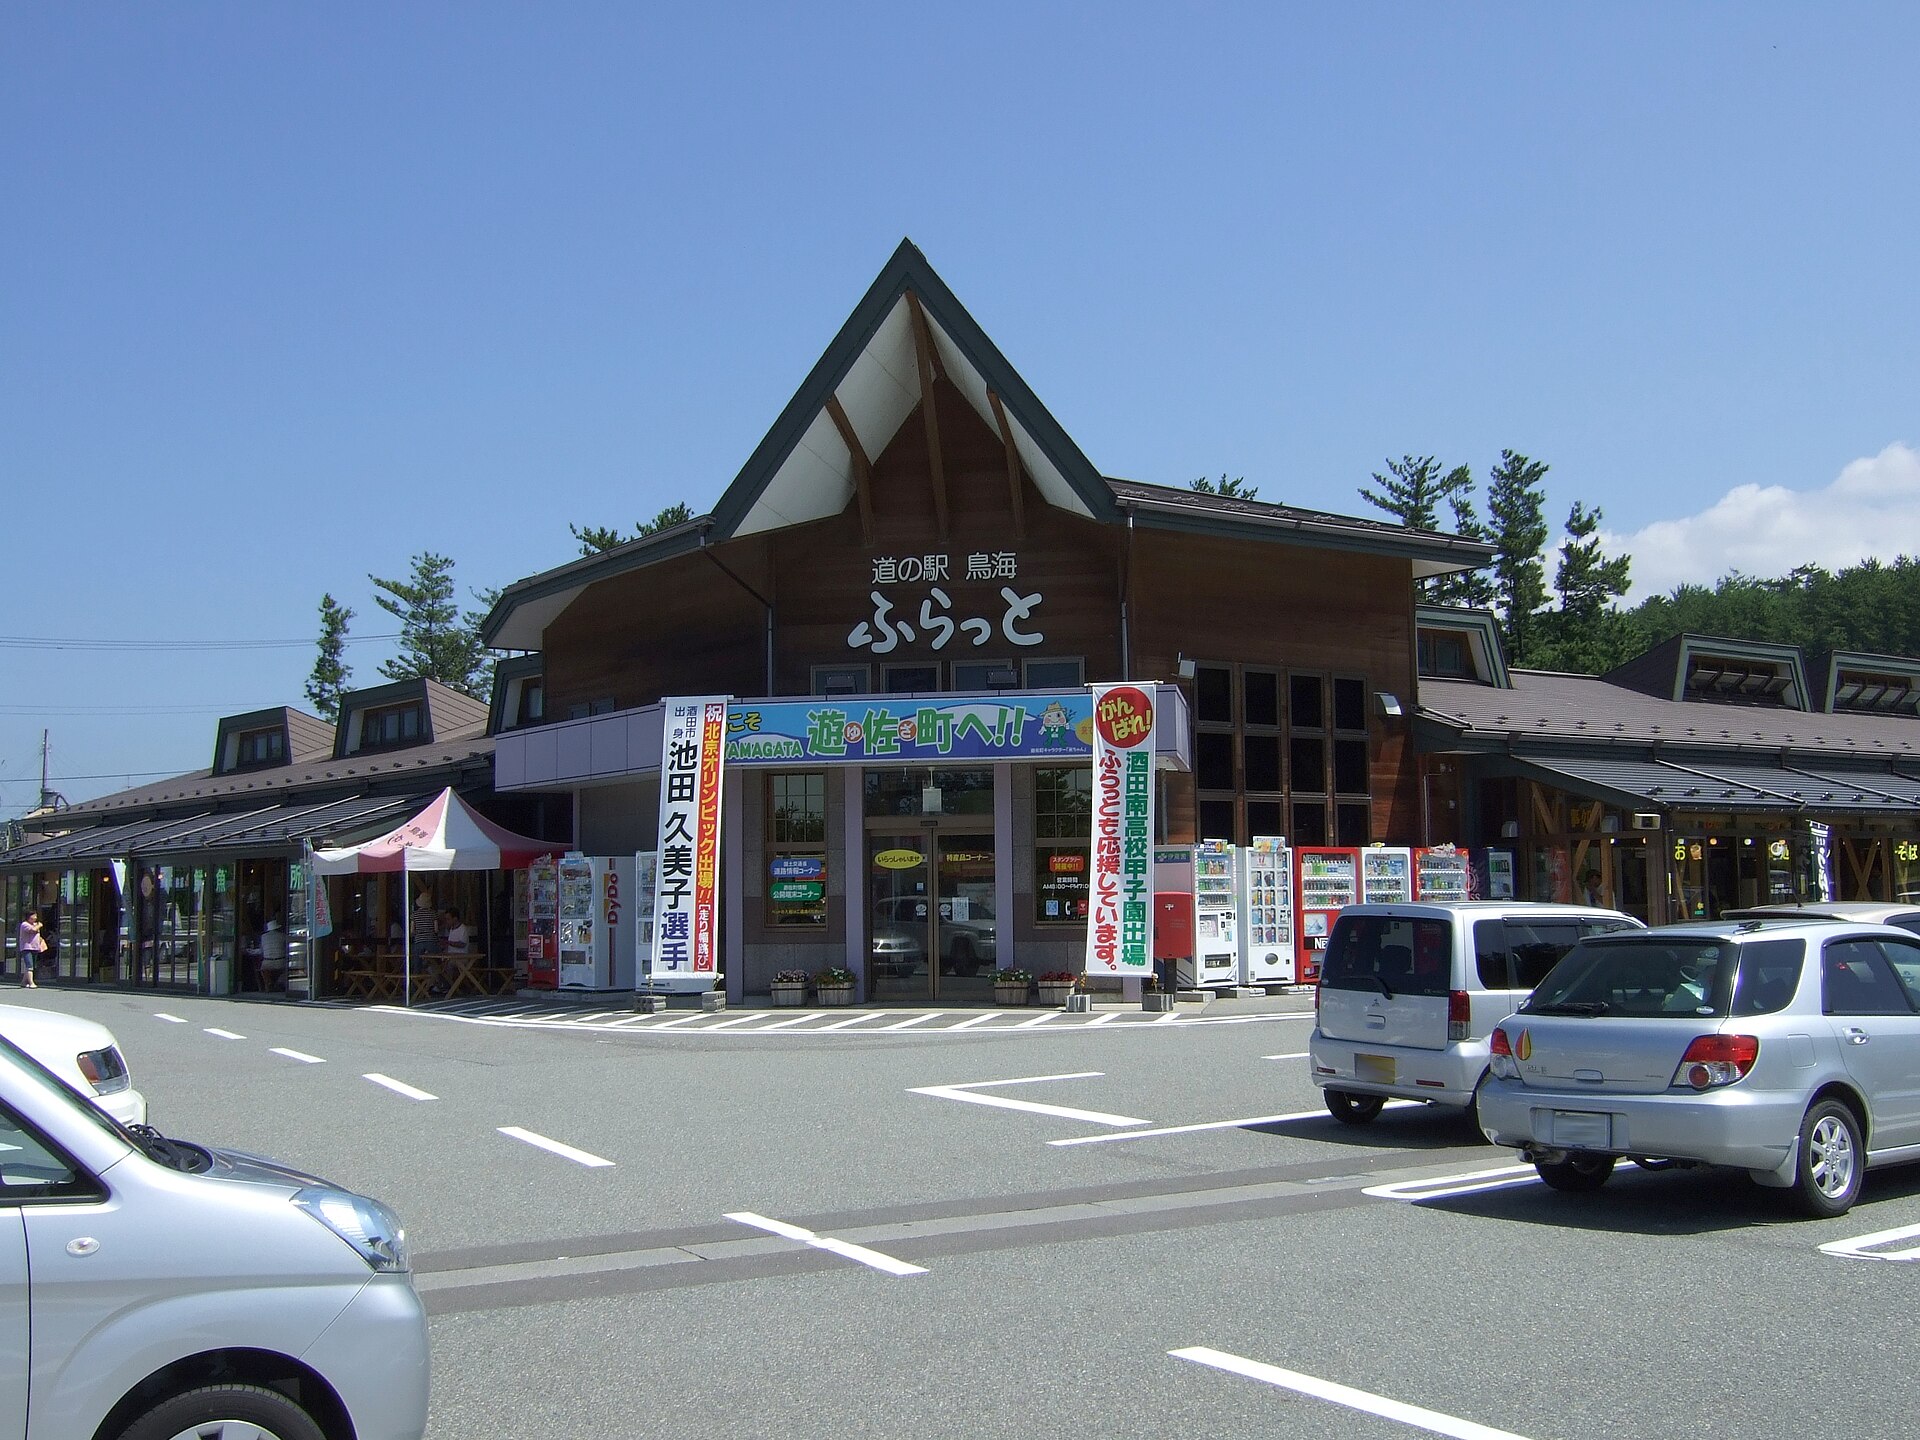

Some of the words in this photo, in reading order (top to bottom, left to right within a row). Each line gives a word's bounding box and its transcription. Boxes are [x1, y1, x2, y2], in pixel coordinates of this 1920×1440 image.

[871, 554, 950, 584] 道の駅
[965, 550, 1018, 580] 鳥海
[847, 586, 1044, 654] ふらっと
[672, 706, 685, 739] 出身
[685, 705, 698, 739] 酒田市
[725, 711, 762, 735] こそ
[1099, 696, 1134, 722] がん
[1111, 709, 1152, 742] ばれ!
[773, 867, 820, 875] 道路情報コーナー
[877, 855, 921, 863] いらっしゃいませ
[1094, 749, 1122, 971] ふらっとも応援しています。
[1122, 751, 1150, 967] 酒田南高校甲子園出場
[607, 873, 622, 924] DyDo
